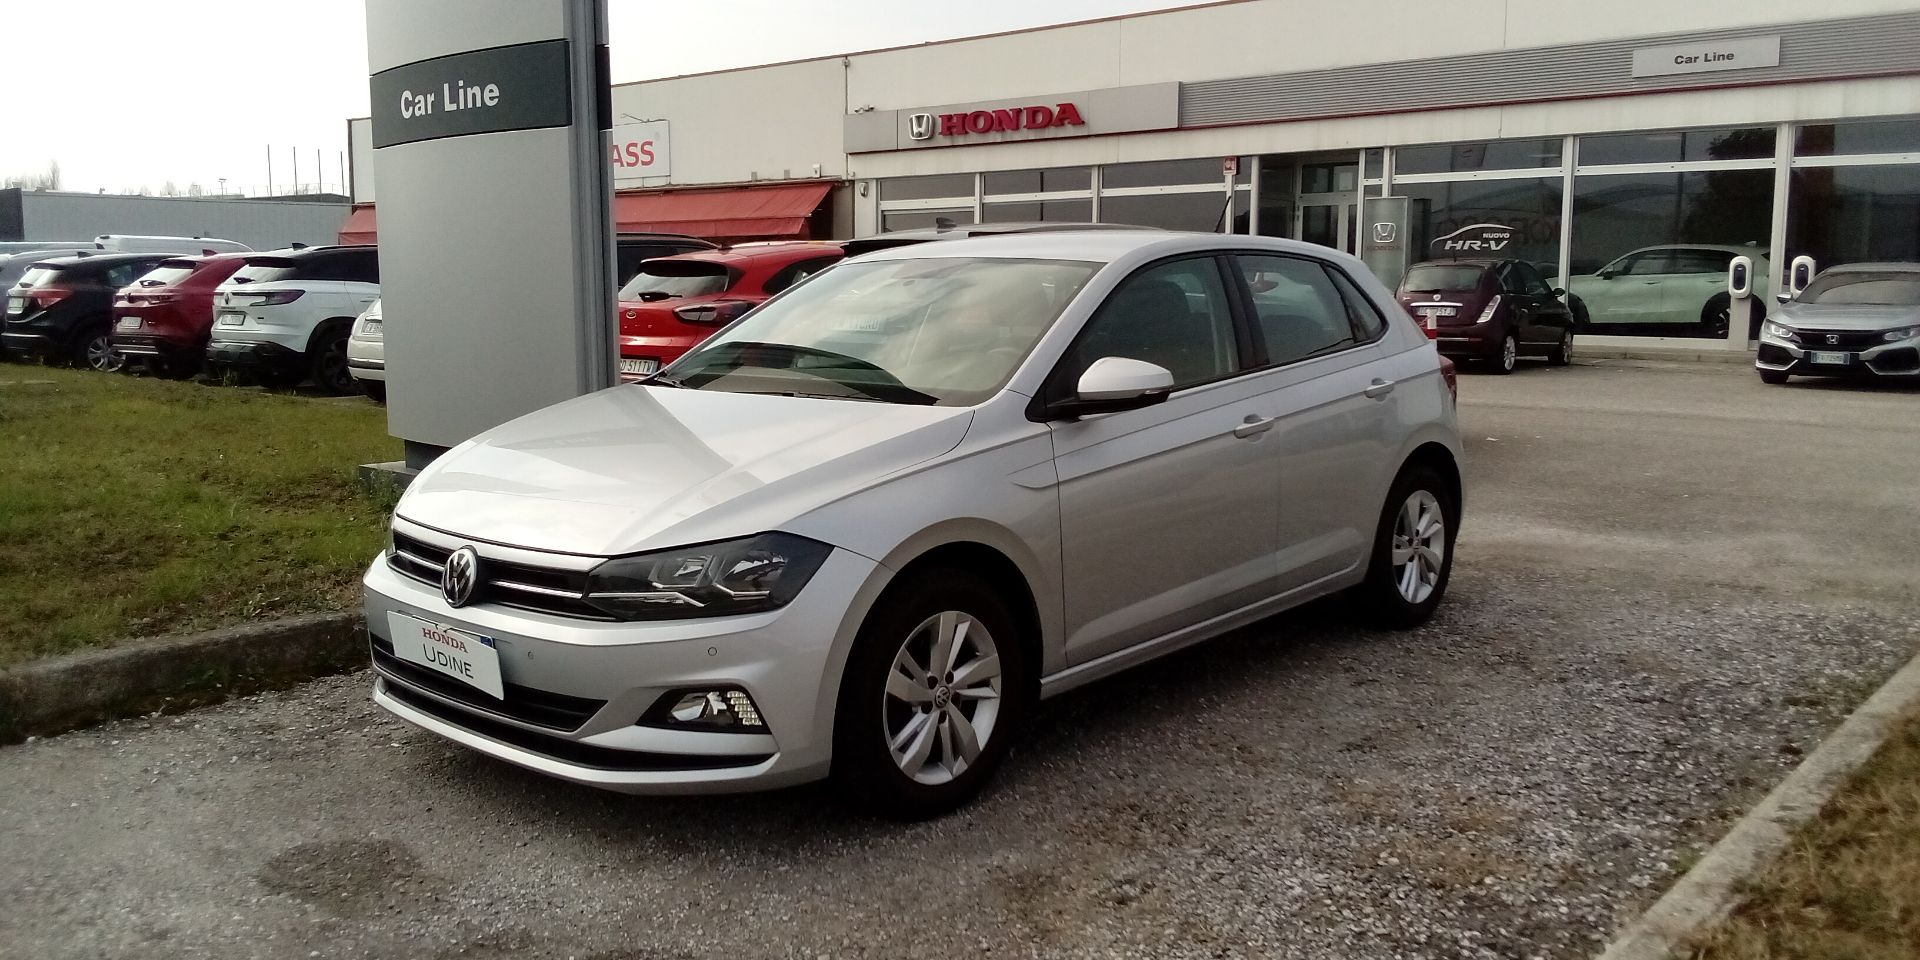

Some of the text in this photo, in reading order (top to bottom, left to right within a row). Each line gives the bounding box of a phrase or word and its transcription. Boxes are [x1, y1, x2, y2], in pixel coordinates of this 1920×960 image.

[1674, 52, 1735, 65] Car Line
[400, 80, 500, 119] Car Line
[938, 102, 1085, 136] HONDA
[1444, 240, 1509, 251] HR-V
[422, 627, 468, 654] HONDA
[423, 643, 474, 680] UDINE
